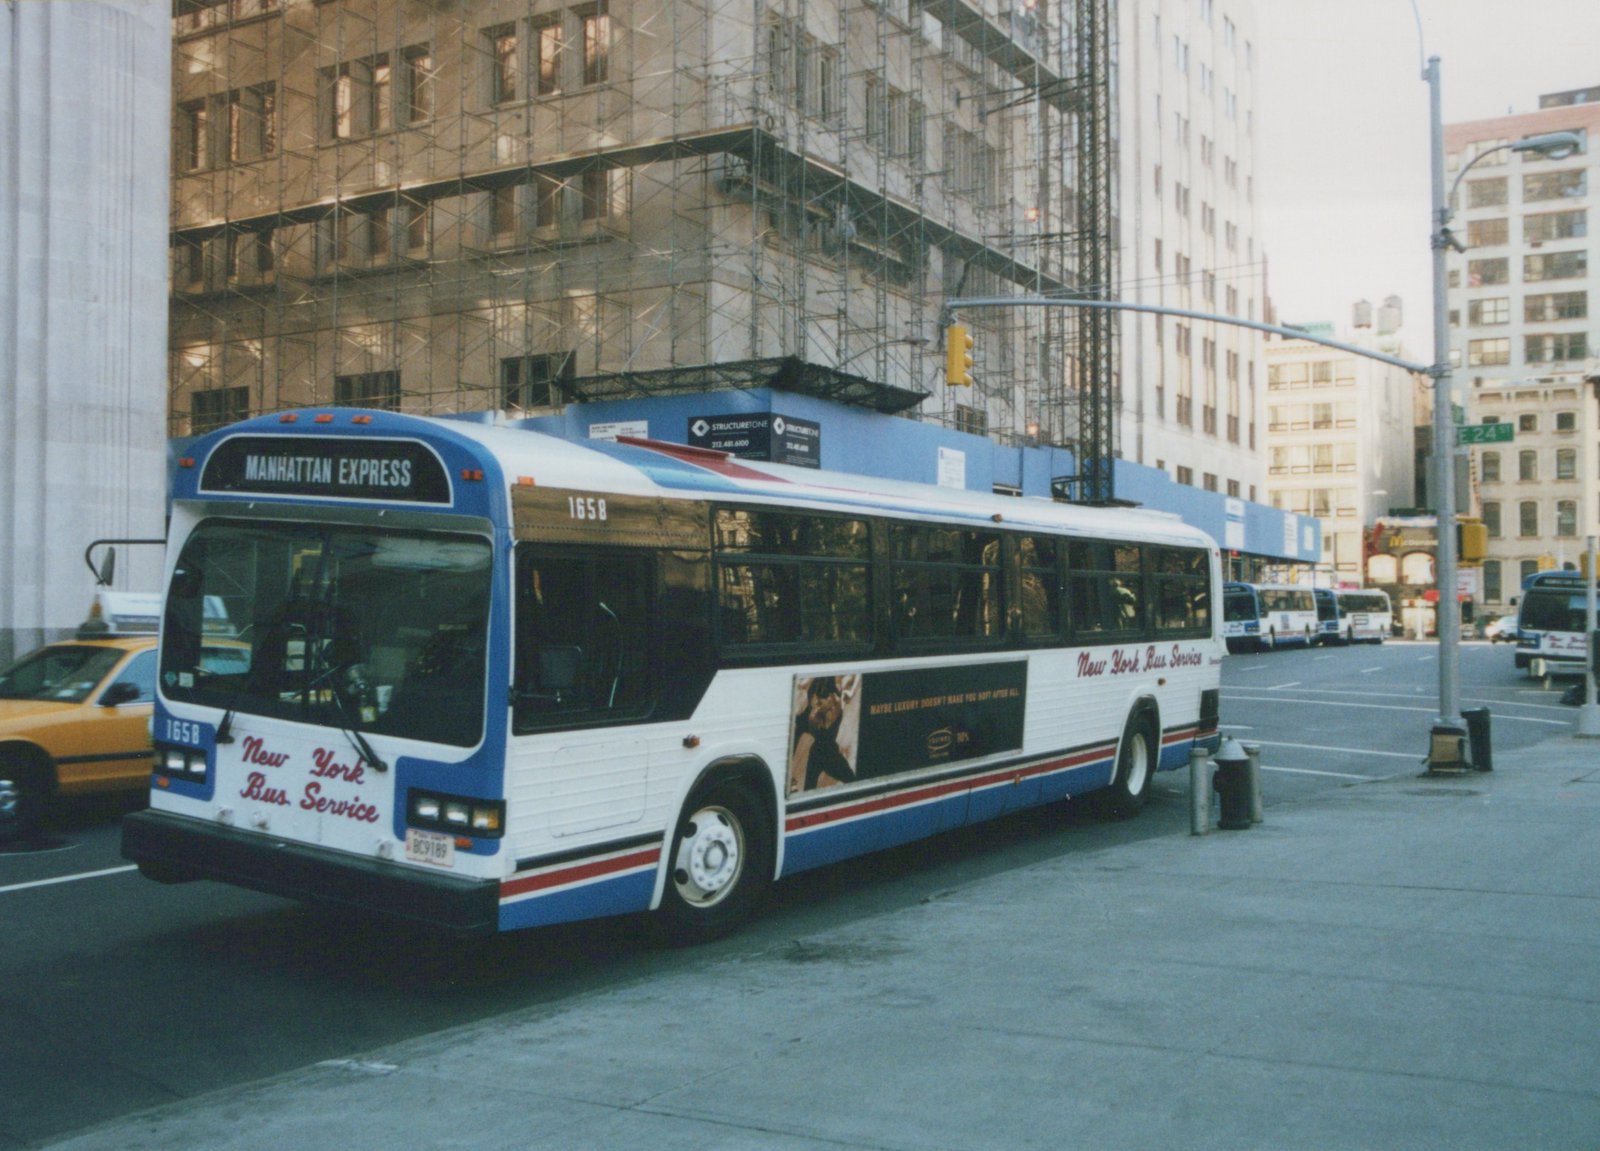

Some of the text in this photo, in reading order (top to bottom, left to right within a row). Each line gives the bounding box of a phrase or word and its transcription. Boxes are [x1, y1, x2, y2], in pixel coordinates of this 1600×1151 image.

[1460, 428, 1468, 443] E
[1473, 426, 1496, 442] 24
[245, 454, 411, 488] MANHATTAN EXPRESS
[568, 496, 607, 521] 1658
[1077, 644, 1202, 678] New York Bus Service
[870, 703, 892, 714] MAYBE
[894, 700, 919, 711] LUXURY
[920, 696, 946, 708] DOESN'T
[947, 694, 963, 704] MAKE
[965, 692, 976, 702] YOU
[978, 690, 991, 701] SOFT
[992, 688, 1008, 698] AFTER
[166, 719, 200, 745] 1658
[242, 736, 365, 785] New York
[240, 772, 379, 823] Bus Service
